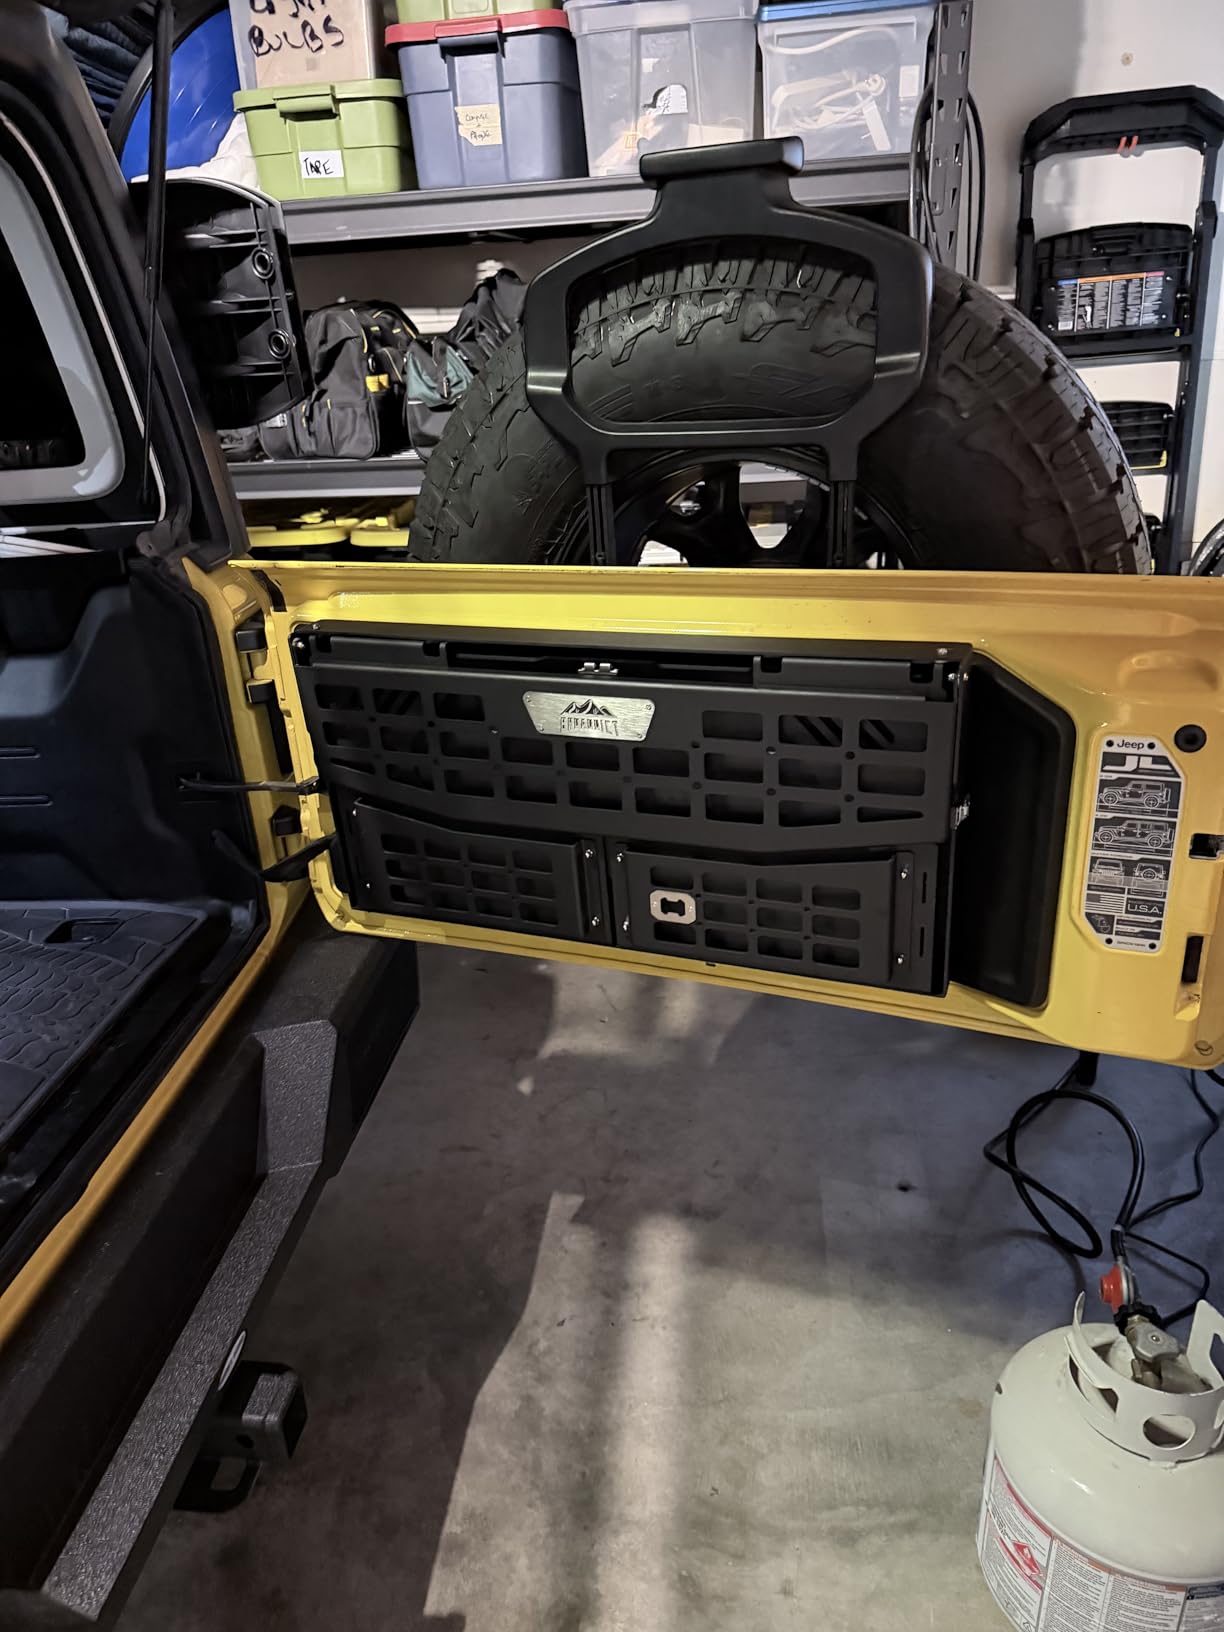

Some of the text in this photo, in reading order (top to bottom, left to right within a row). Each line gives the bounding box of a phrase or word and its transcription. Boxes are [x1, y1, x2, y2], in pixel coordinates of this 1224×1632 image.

[248, 14, 344, 57] BULBS
[303, 157, 334, 176] TAPE
[1116, 739, 1145, 751] Jeep
[1102, 755, 1173, 772] JL
[1127, 903, 1163, 915] U.S.A.
